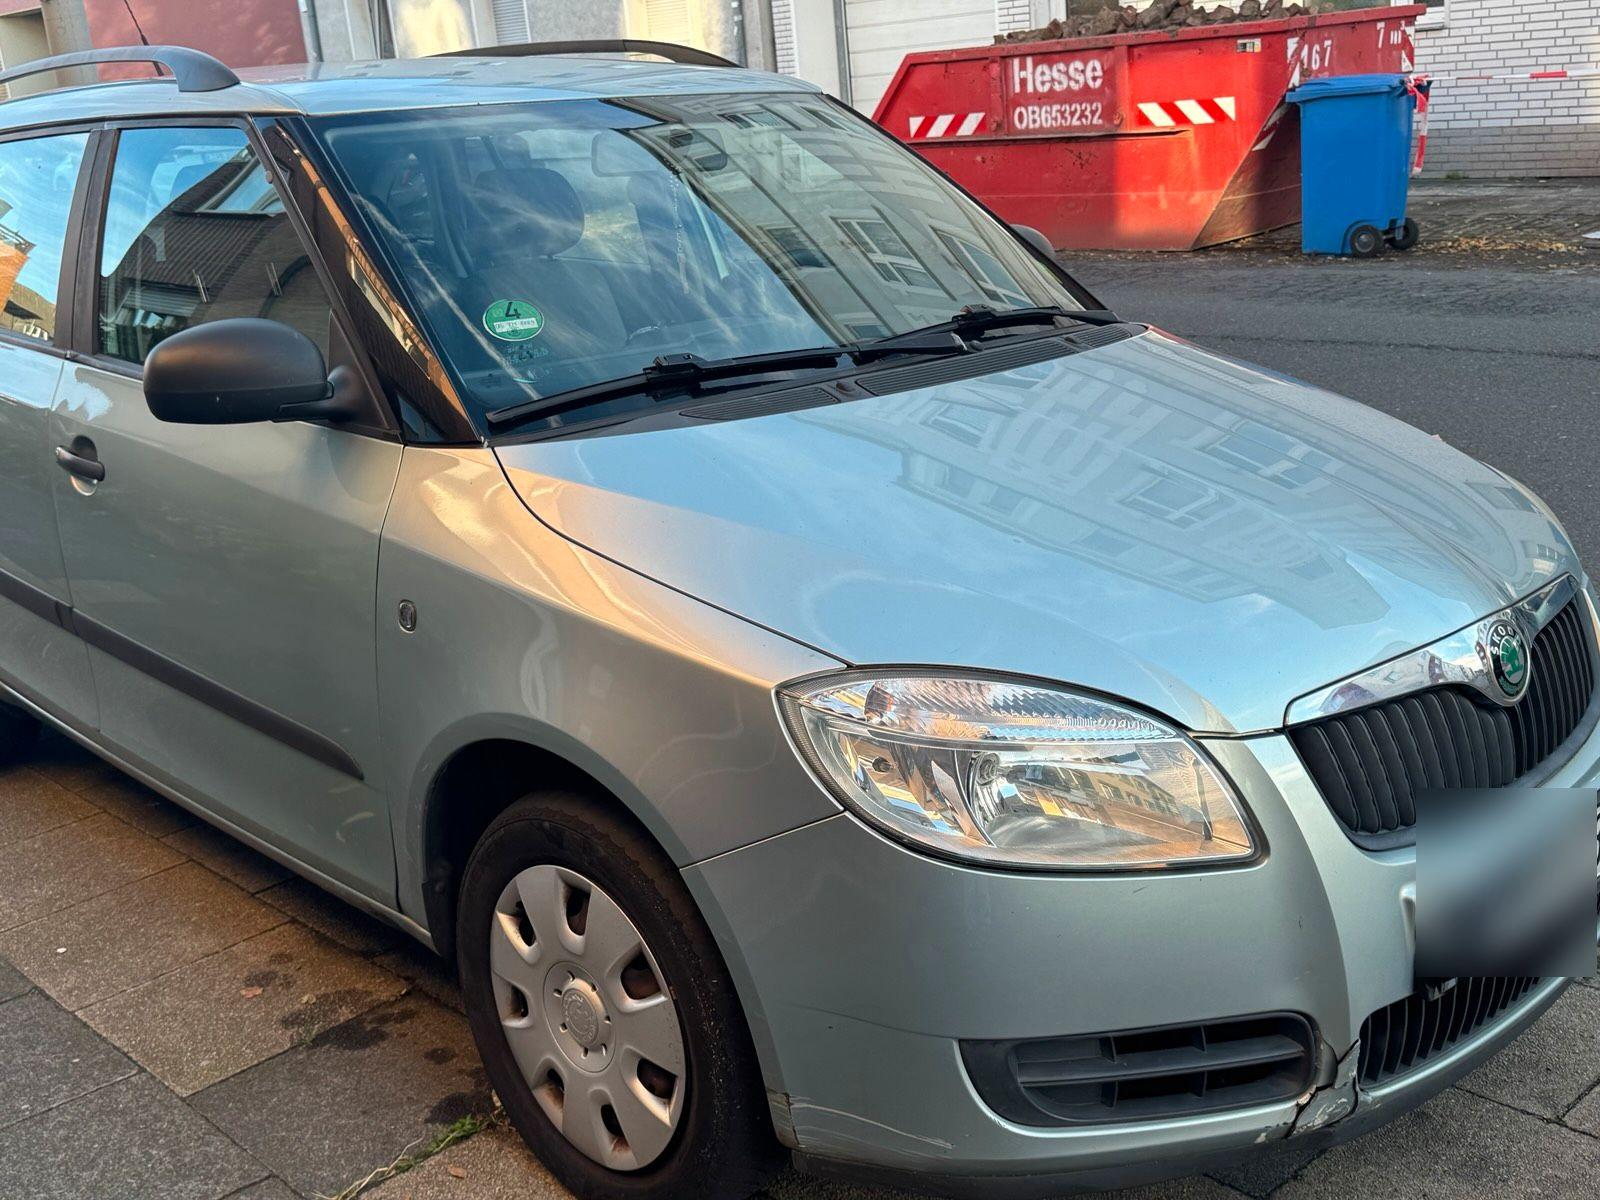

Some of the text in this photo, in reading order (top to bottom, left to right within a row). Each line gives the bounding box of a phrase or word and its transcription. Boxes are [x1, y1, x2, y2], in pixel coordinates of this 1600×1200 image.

[1376, 22, 1385, 48] 7
[1300, 40, 1332, 70] 167
[1013, 56, 1103, 93] Hesse
[1013, 102, 1103, 129] OB653232
[505, 301, 521, 318] 4
